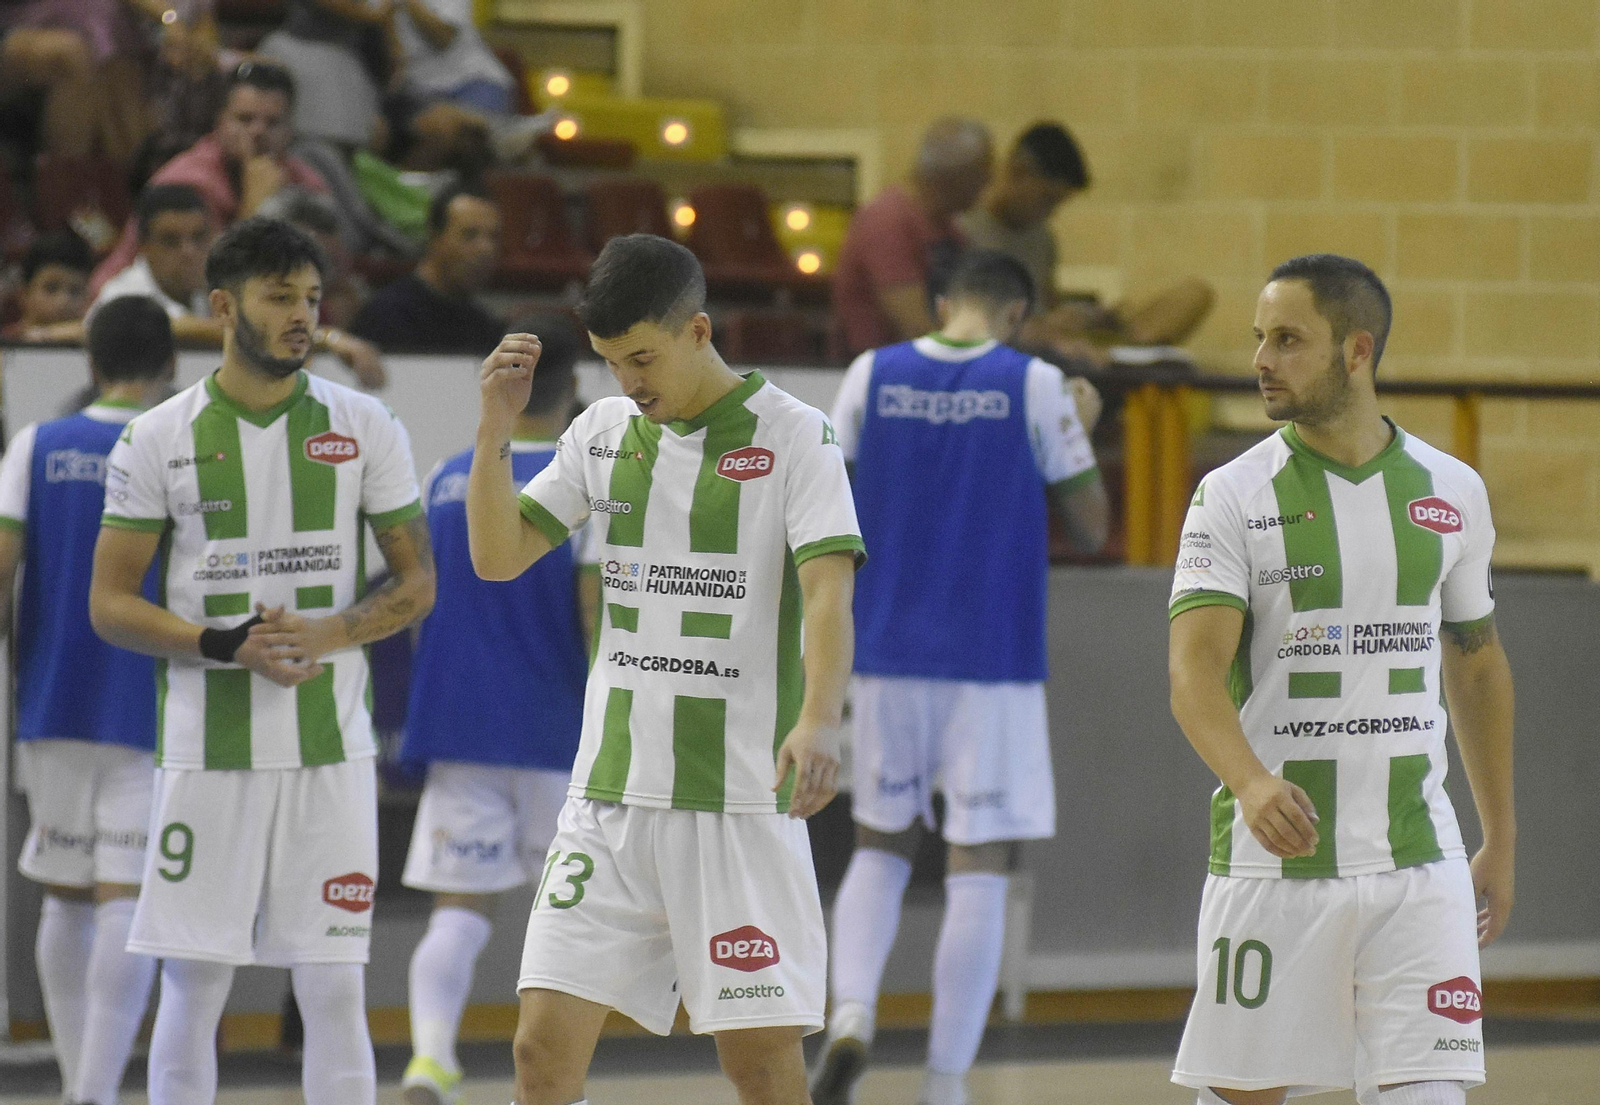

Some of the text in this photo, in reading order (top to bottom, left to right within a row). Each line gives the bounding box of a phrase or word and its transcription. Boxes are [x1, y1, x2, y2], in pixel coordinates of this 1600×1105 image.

[310, 440, 356, 456] Deza
[589, 445, 634, 460] cajasur
[721, 454, 771, 471] Deza
[1247, 513, 1303, 532] cajasur
[1414, 505, 1460, 527] Deza
[258, 557, 341, 577] HUMANIDAD
[648, 564, 738, 584] PATRIMONIO
[1258, 564, 1325, 586] Mosttro
[645, 579, 746, 599] HUMANIDAD
[158, 822, 195, 882] 9
[534, 850, 595, 911] 13
[716, 939, 774, 959] Deza
[1211, 936, 1273, 1010] 10
[718, 984, 785, 1000] Mosttro
[1433, 1037, 1481, 1053] Mosttr
